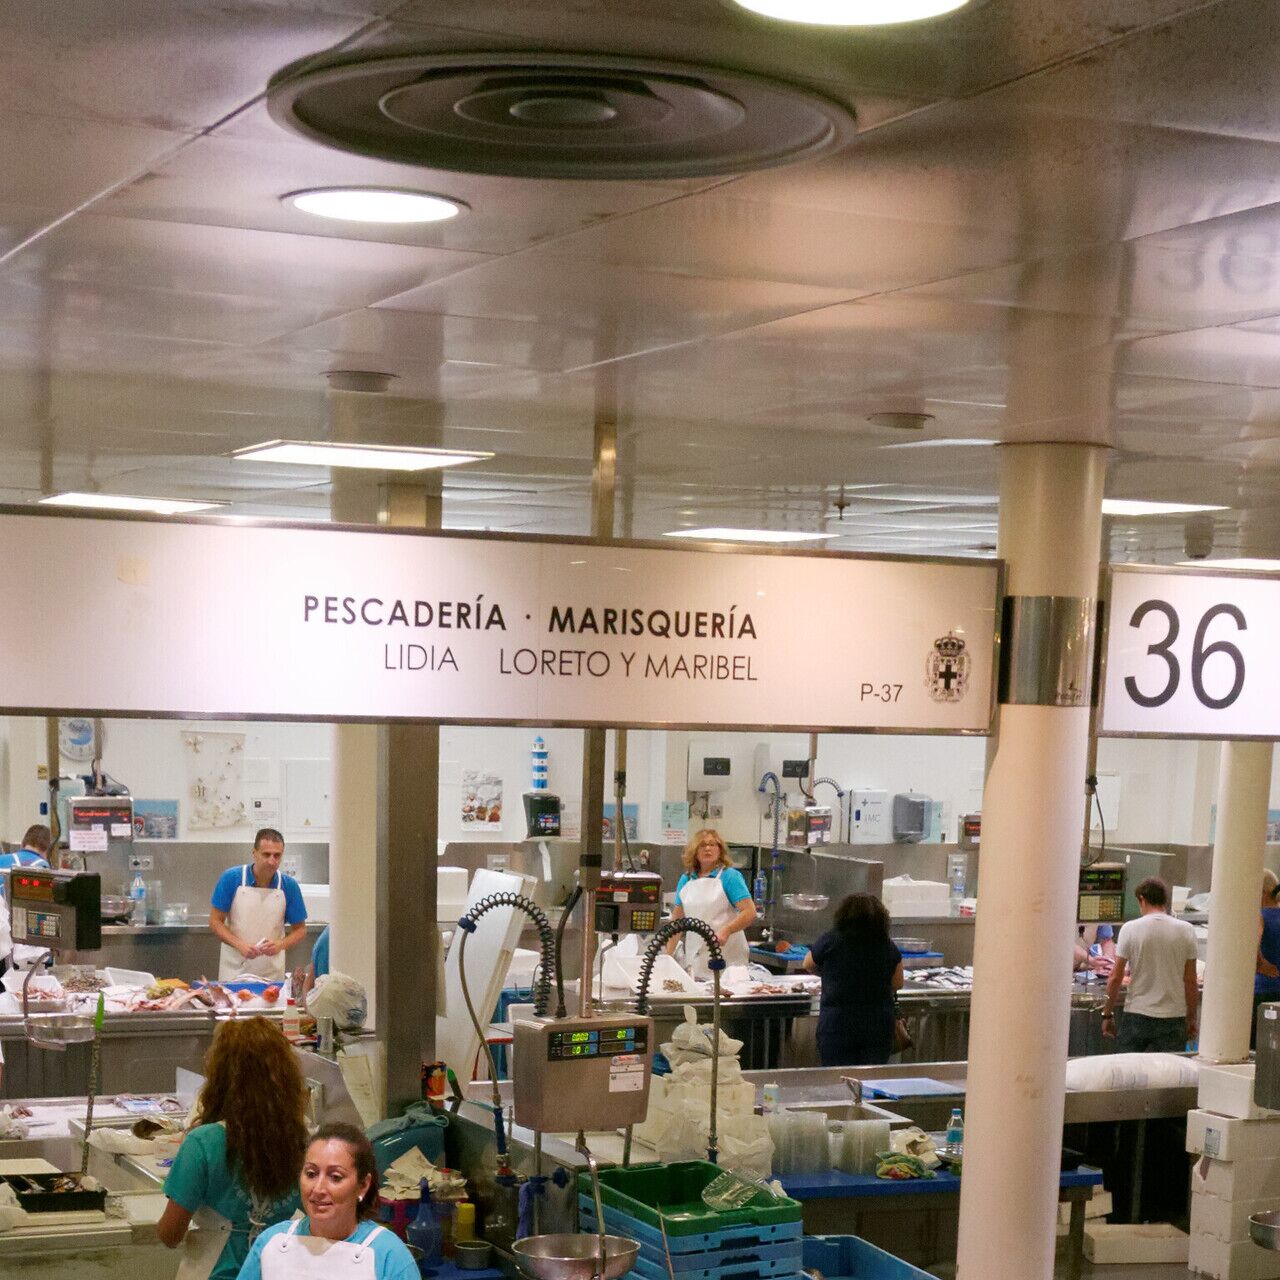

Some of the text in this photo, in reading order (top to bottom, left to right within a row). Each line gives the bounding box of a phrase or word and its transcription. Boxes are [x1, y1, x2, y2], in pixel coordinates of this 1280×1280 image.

[303, 593, 758, 640] PESCADERÍA MARISQUERÍA
[384, 643, 759, 682] LIDIA LORETO Y MARIBEL
[1124, 599, 1248, 710] 36
[860, 682, 904, 704] P-37
